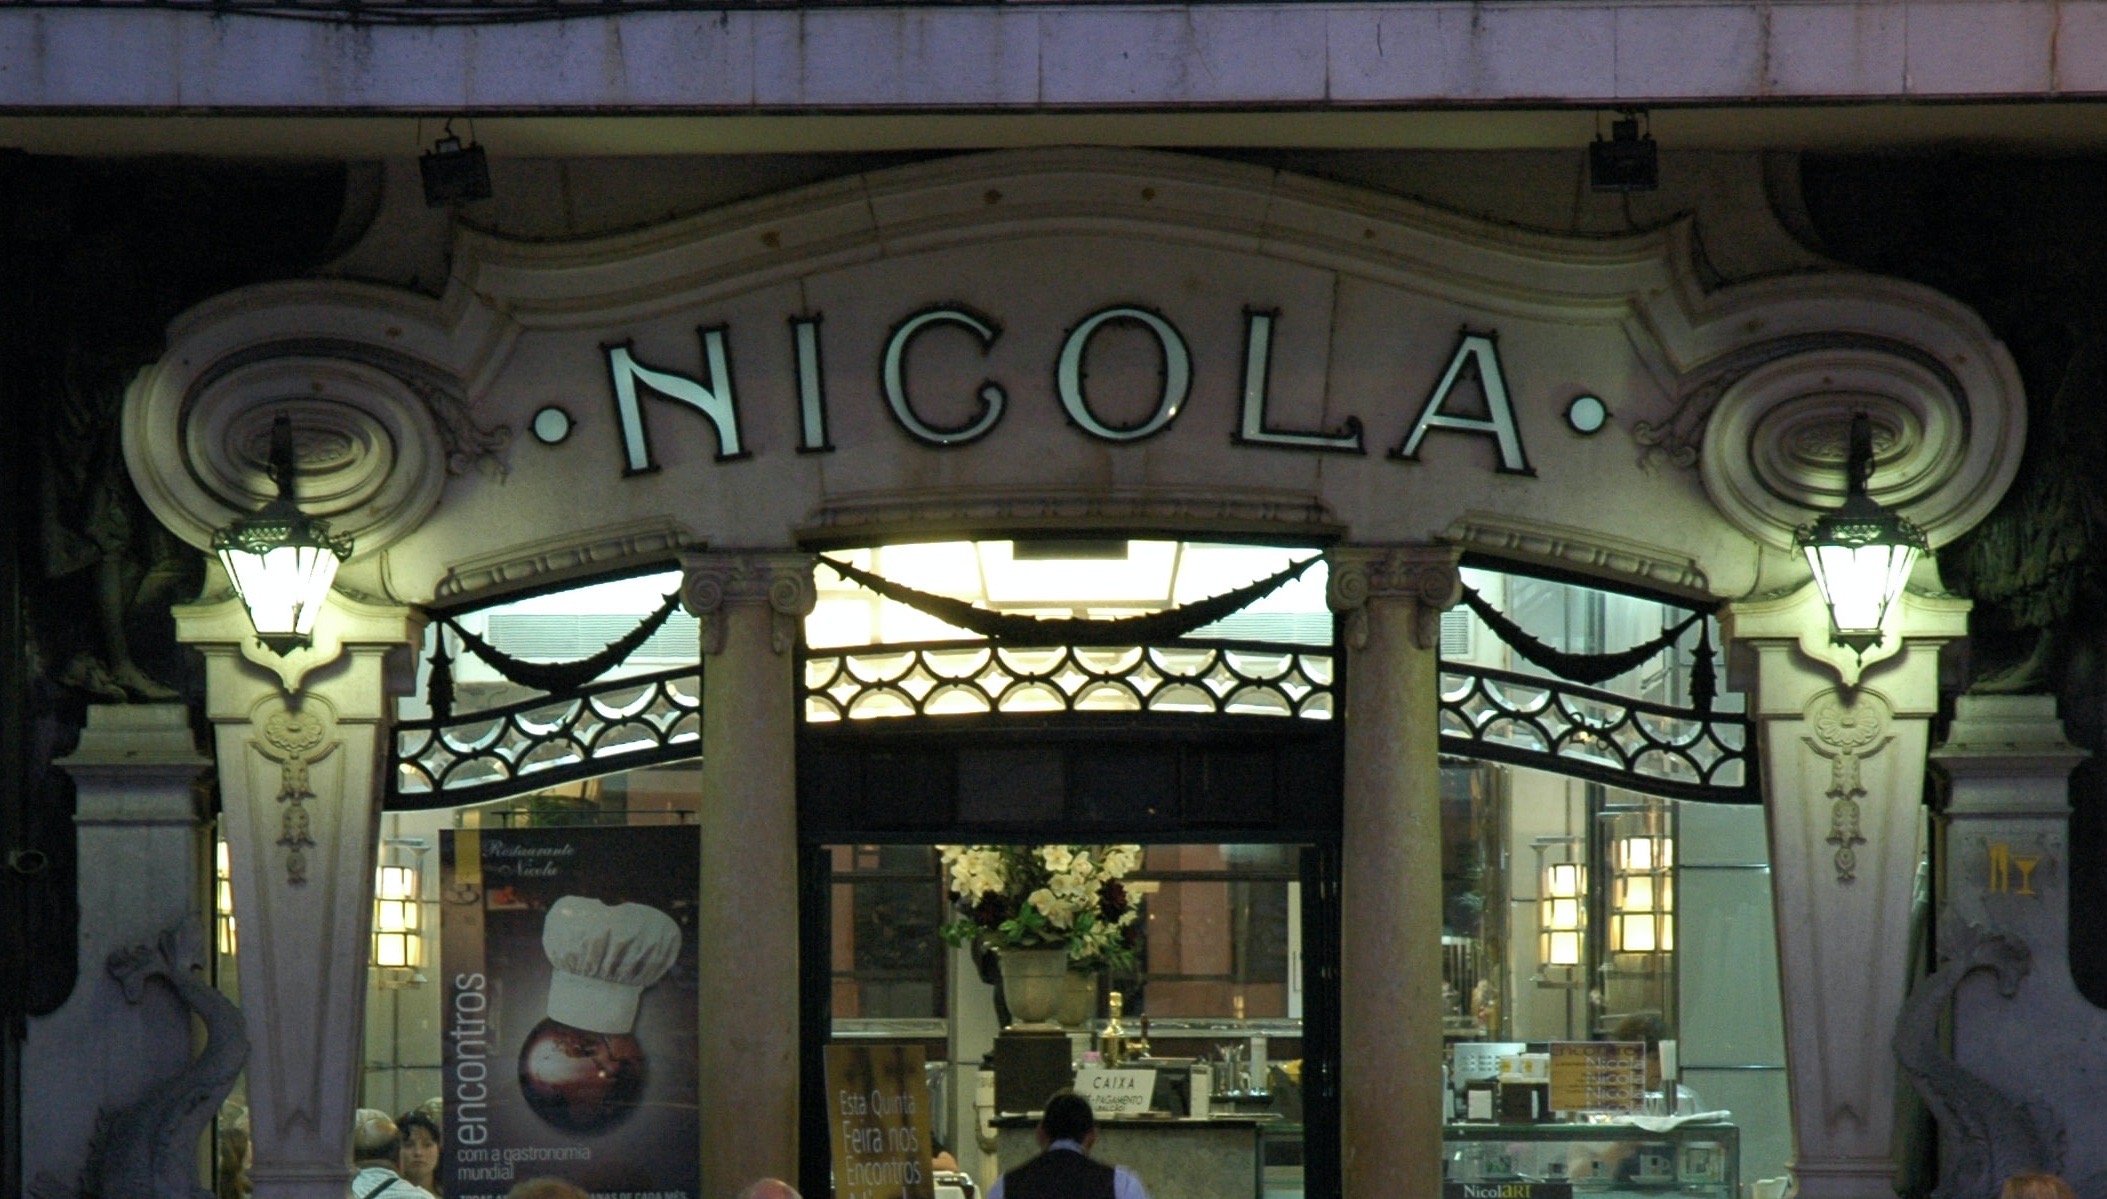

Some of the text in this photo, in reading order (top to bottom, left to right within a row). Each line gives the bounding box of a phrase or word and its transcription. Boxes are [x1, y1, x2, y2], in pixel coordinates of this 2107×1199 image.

[601, 302, 1537, 477] NICOLA
[451, 973, 487, 1145] encontros
[1092, 1076, 1135, 1089] CAIXA
[840, 1089, 916, 1117] Esta Quinta
[843, 1119, 919, 1154] Feira nos
[457, 1146, 591, 1166] com a gastronomia
[846, 1155, 921, 1186] Encontros
[458, 1163, 514, 1181] mundial
